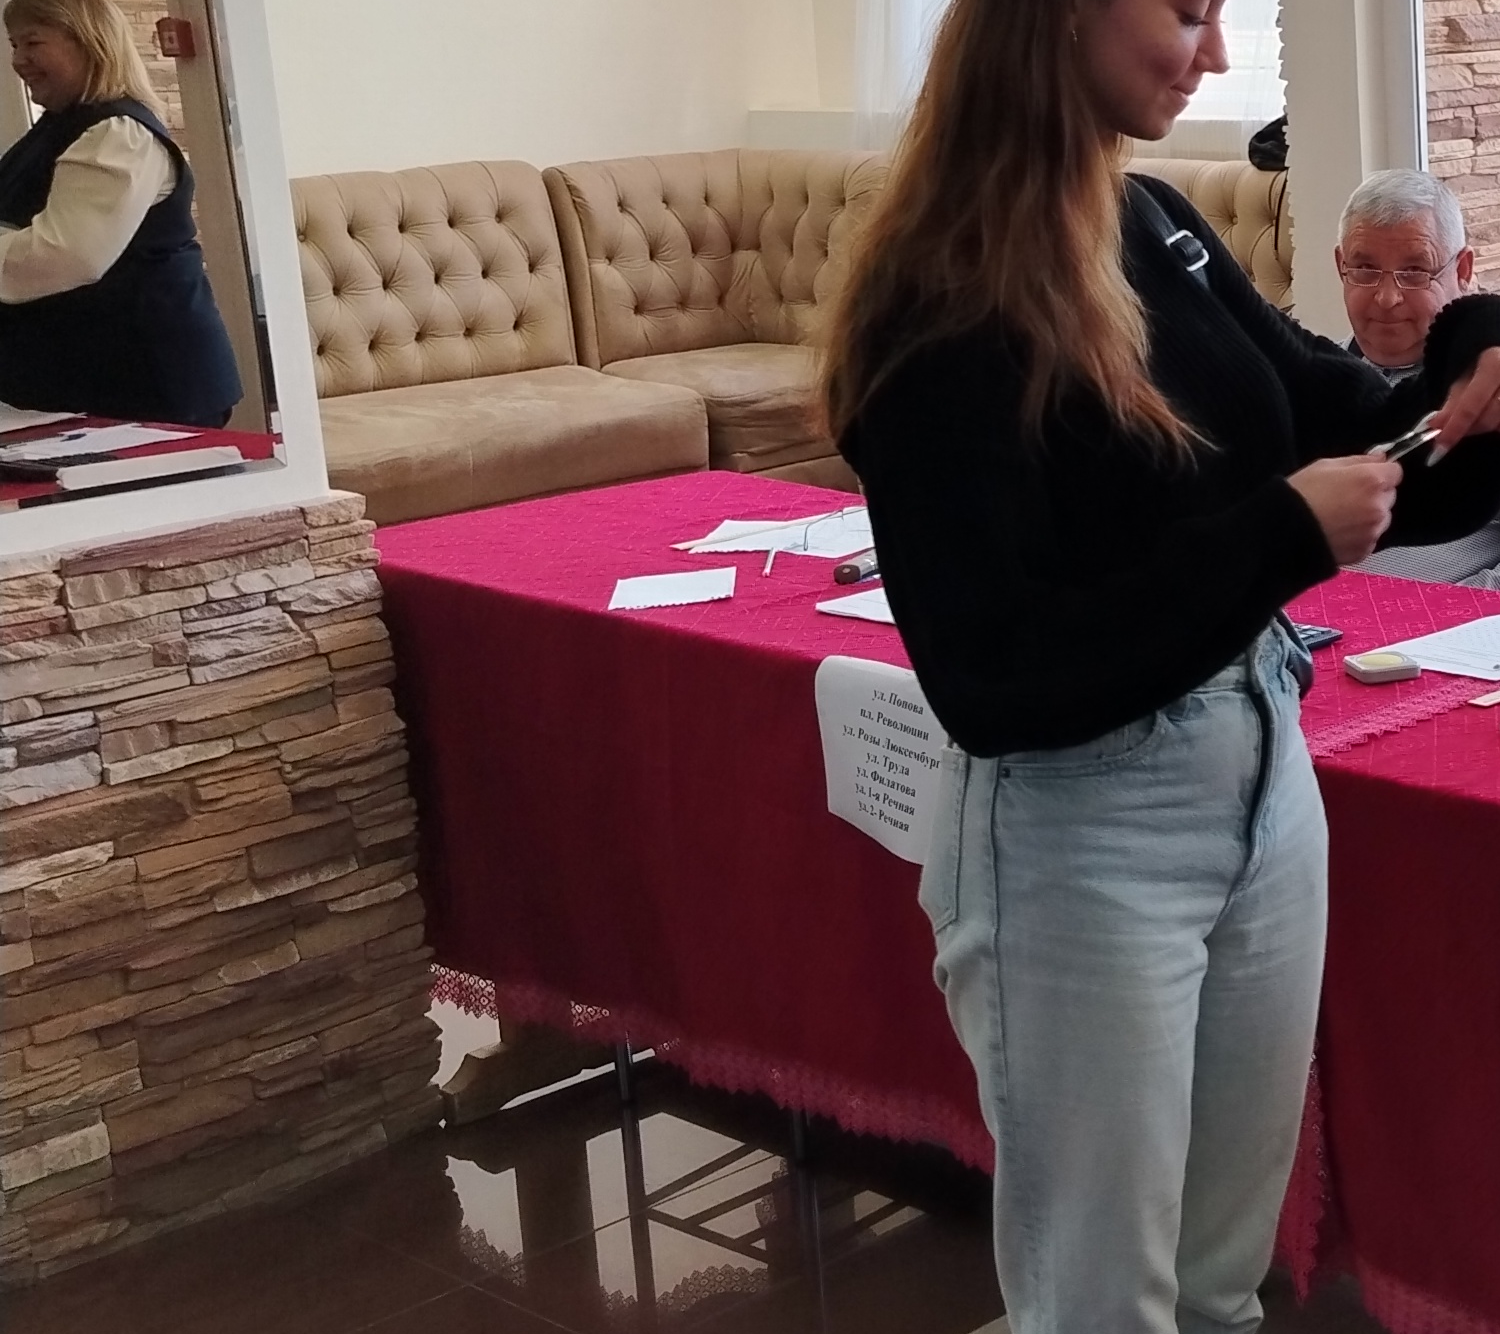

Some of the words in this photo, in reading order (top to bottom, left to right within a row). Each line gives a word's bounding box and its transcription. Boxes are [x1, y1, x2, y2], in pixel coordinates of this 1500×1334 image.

[872, 689, 886, 701] ул.
[889, 692, 924, 715] Попова
[843, 724, 855, 736] ул.
[858, 727, 880, 746] Розы
[860, 708, 874, 721] пл.
[876, 711, 930, 741] Революции
[865, 752, 880, 765] ул.
[883, 755, 910, 776] Труда
[856, 766, 869, 779] ул.
[871, 770, 917, 797] Филатова
[855, 783, 866, 795] ул.
[868, 787, 881, 802] 1-я
[883, 792, 915, 816] Речная
[879, 809, 910, 832] Речная
